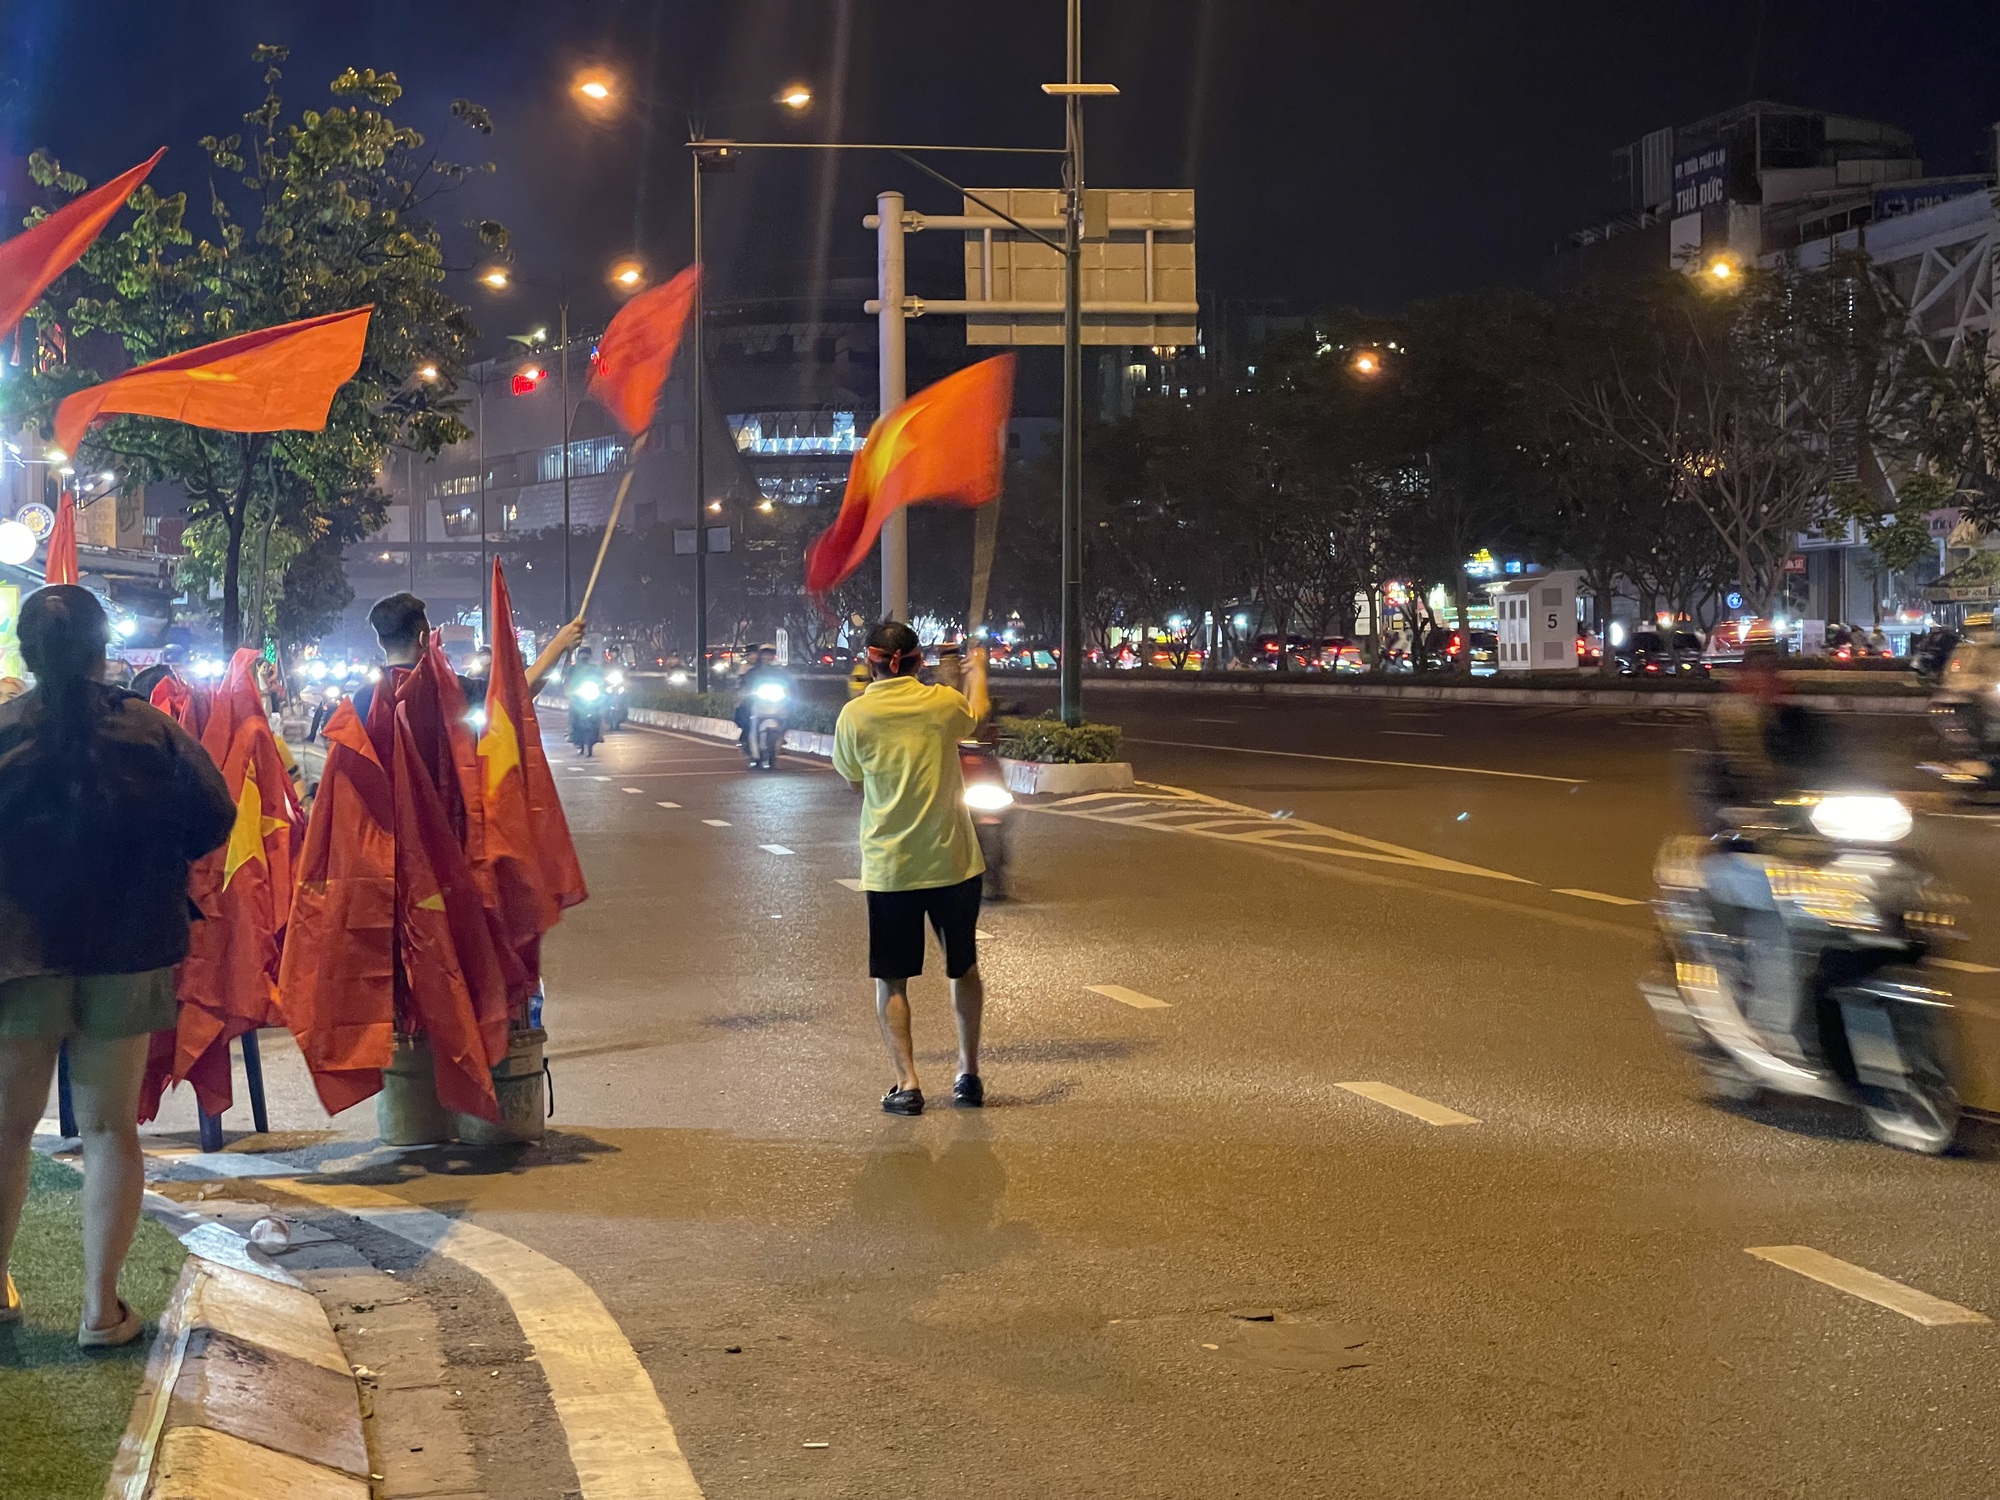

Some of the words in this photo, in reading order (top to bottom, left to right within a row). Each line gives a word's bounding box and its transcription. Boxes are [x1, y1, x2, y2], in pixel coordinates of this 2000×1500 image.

[1676, 179, 1697, 213] THỦ
[1699, 176, 1723, 206] ĐỨC
[1547, 613, 1558, 629] 5
